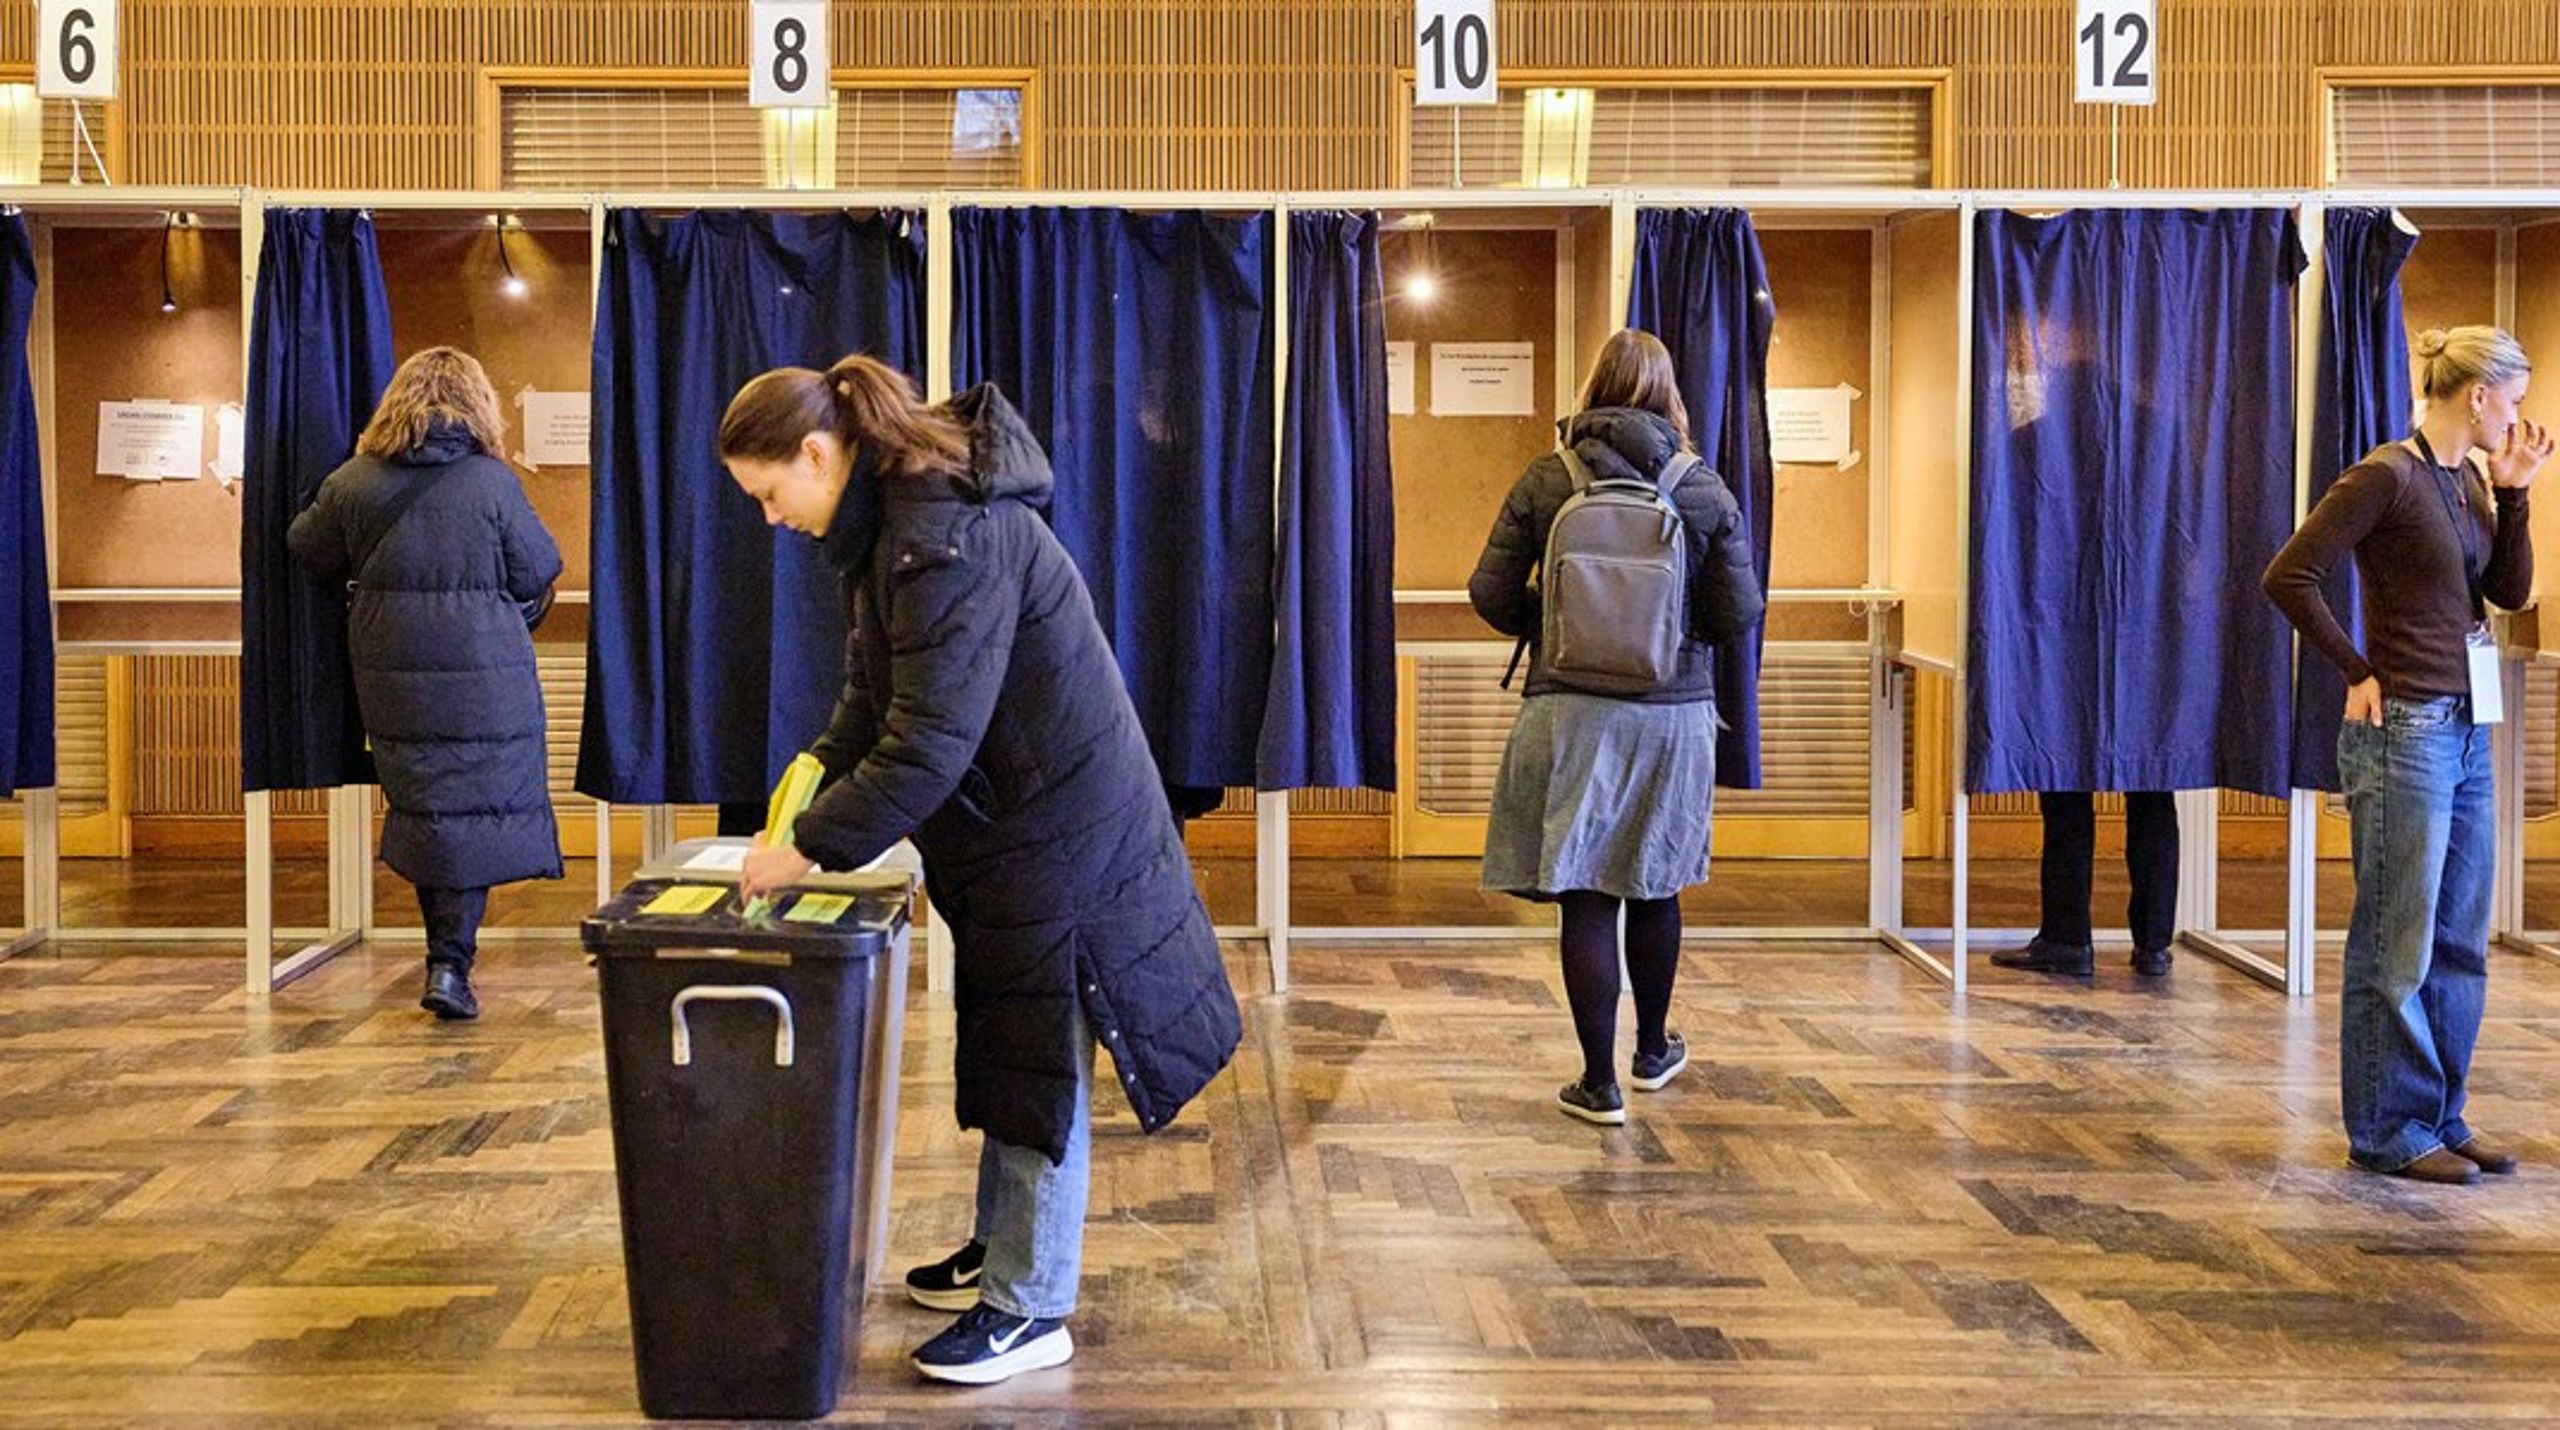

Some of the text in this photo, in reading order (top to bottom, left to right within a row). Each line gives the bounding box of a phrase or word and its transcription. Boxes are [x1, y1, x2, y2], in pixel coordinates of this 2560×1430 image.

[59, 8, 95, 84] 6
[772, 18, 808, 93] 8
[1420, 14, 1489, 89] 10
[2081, 13, 2148, 87] 12
